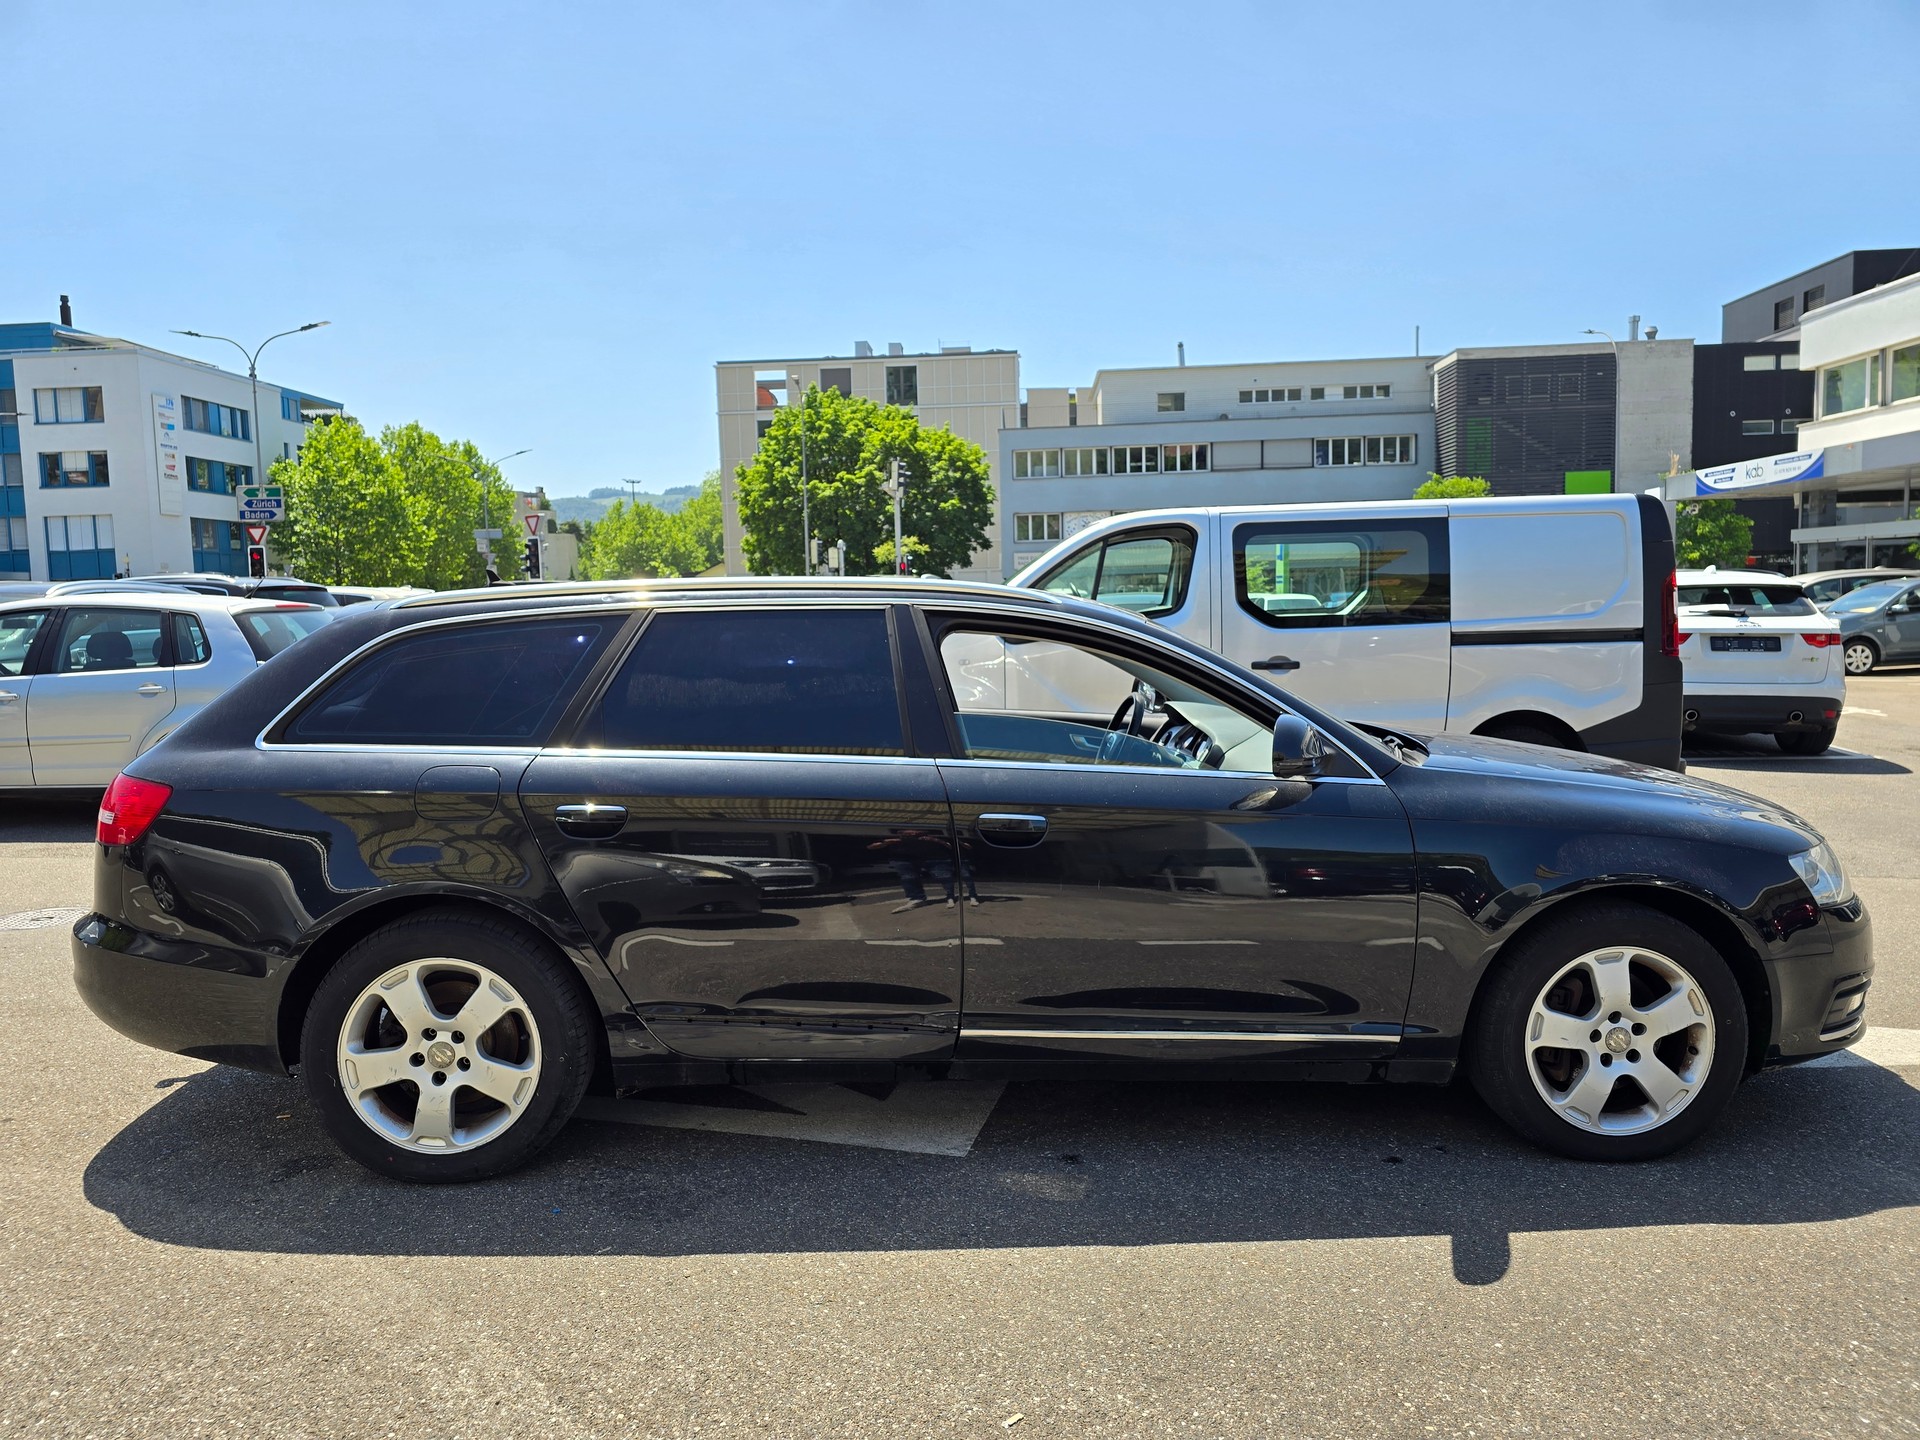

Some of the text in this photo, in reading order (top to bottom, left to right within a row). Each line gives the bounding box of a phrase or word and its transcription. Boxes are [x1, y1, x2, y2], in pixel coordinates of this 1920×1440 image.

[1745, 462, 1764, 480] kab
[252, 500, 277, 508] Zürich
[244, 511, 270, 519] Baden
